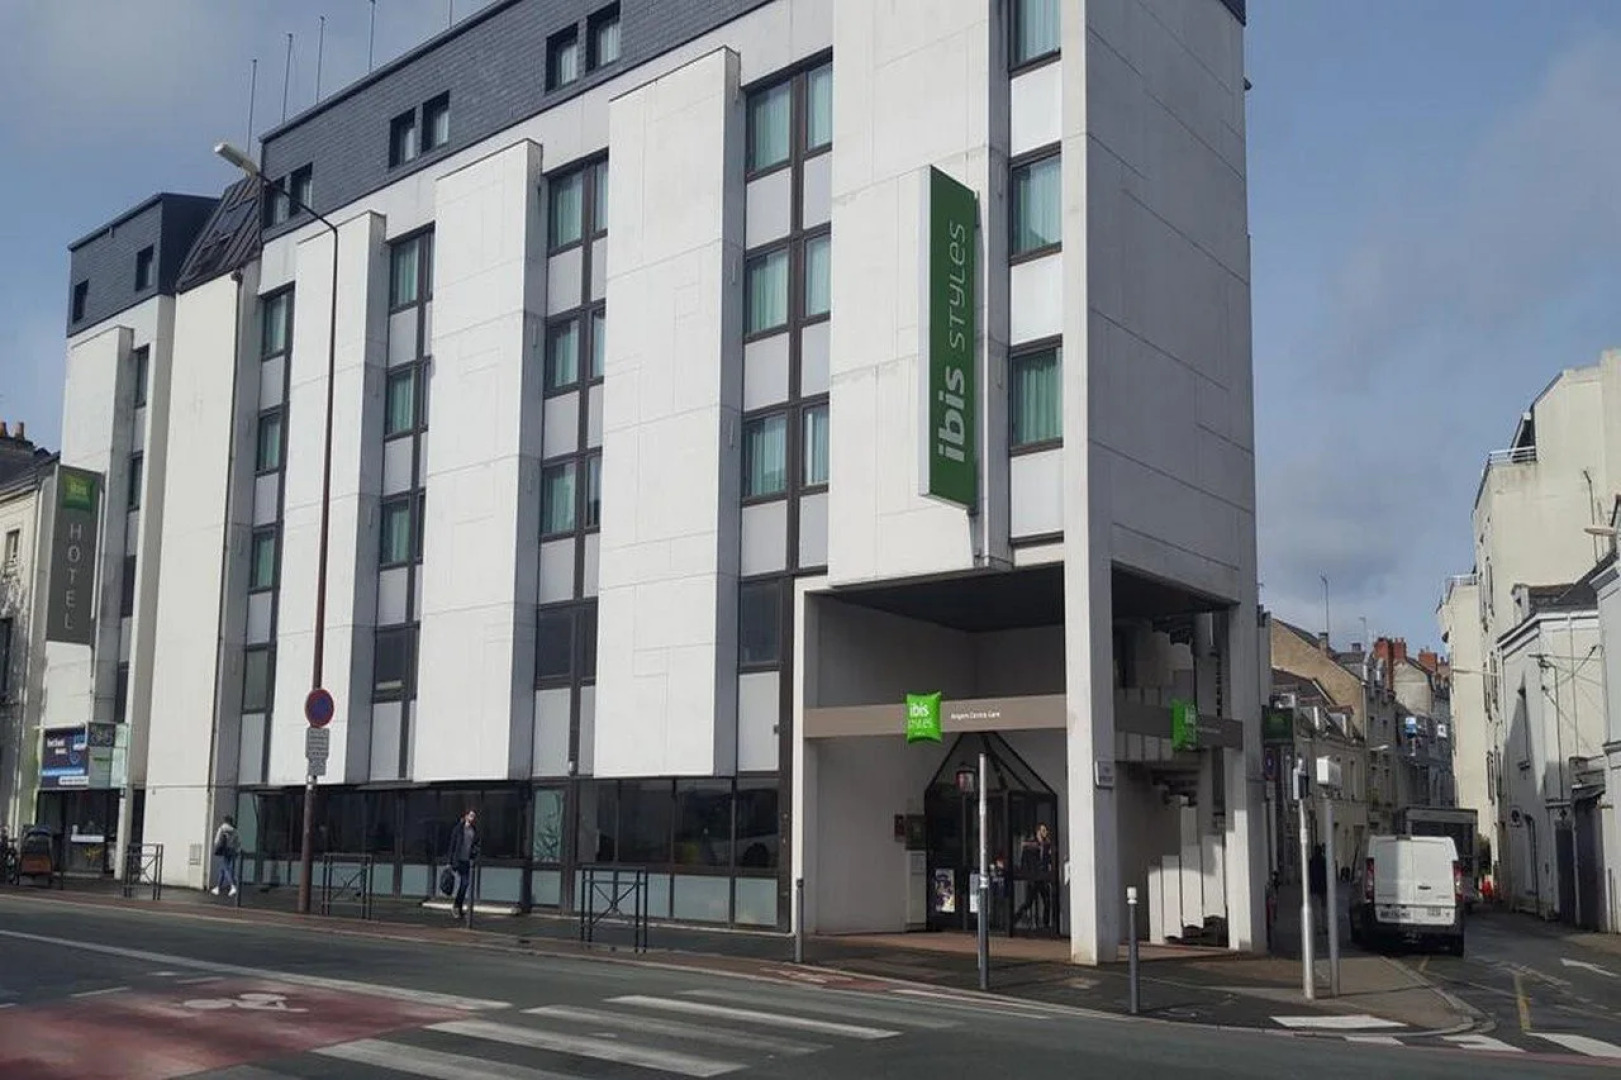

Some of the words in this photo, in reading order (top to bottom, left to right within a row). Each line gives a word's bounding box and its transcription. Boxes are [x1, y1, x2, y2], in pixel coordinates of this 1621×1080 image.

[938, 366, 965, 463] ibis
[64, 523, 82, 630] HOTEL
[909, 702, 929, 718] ibis
